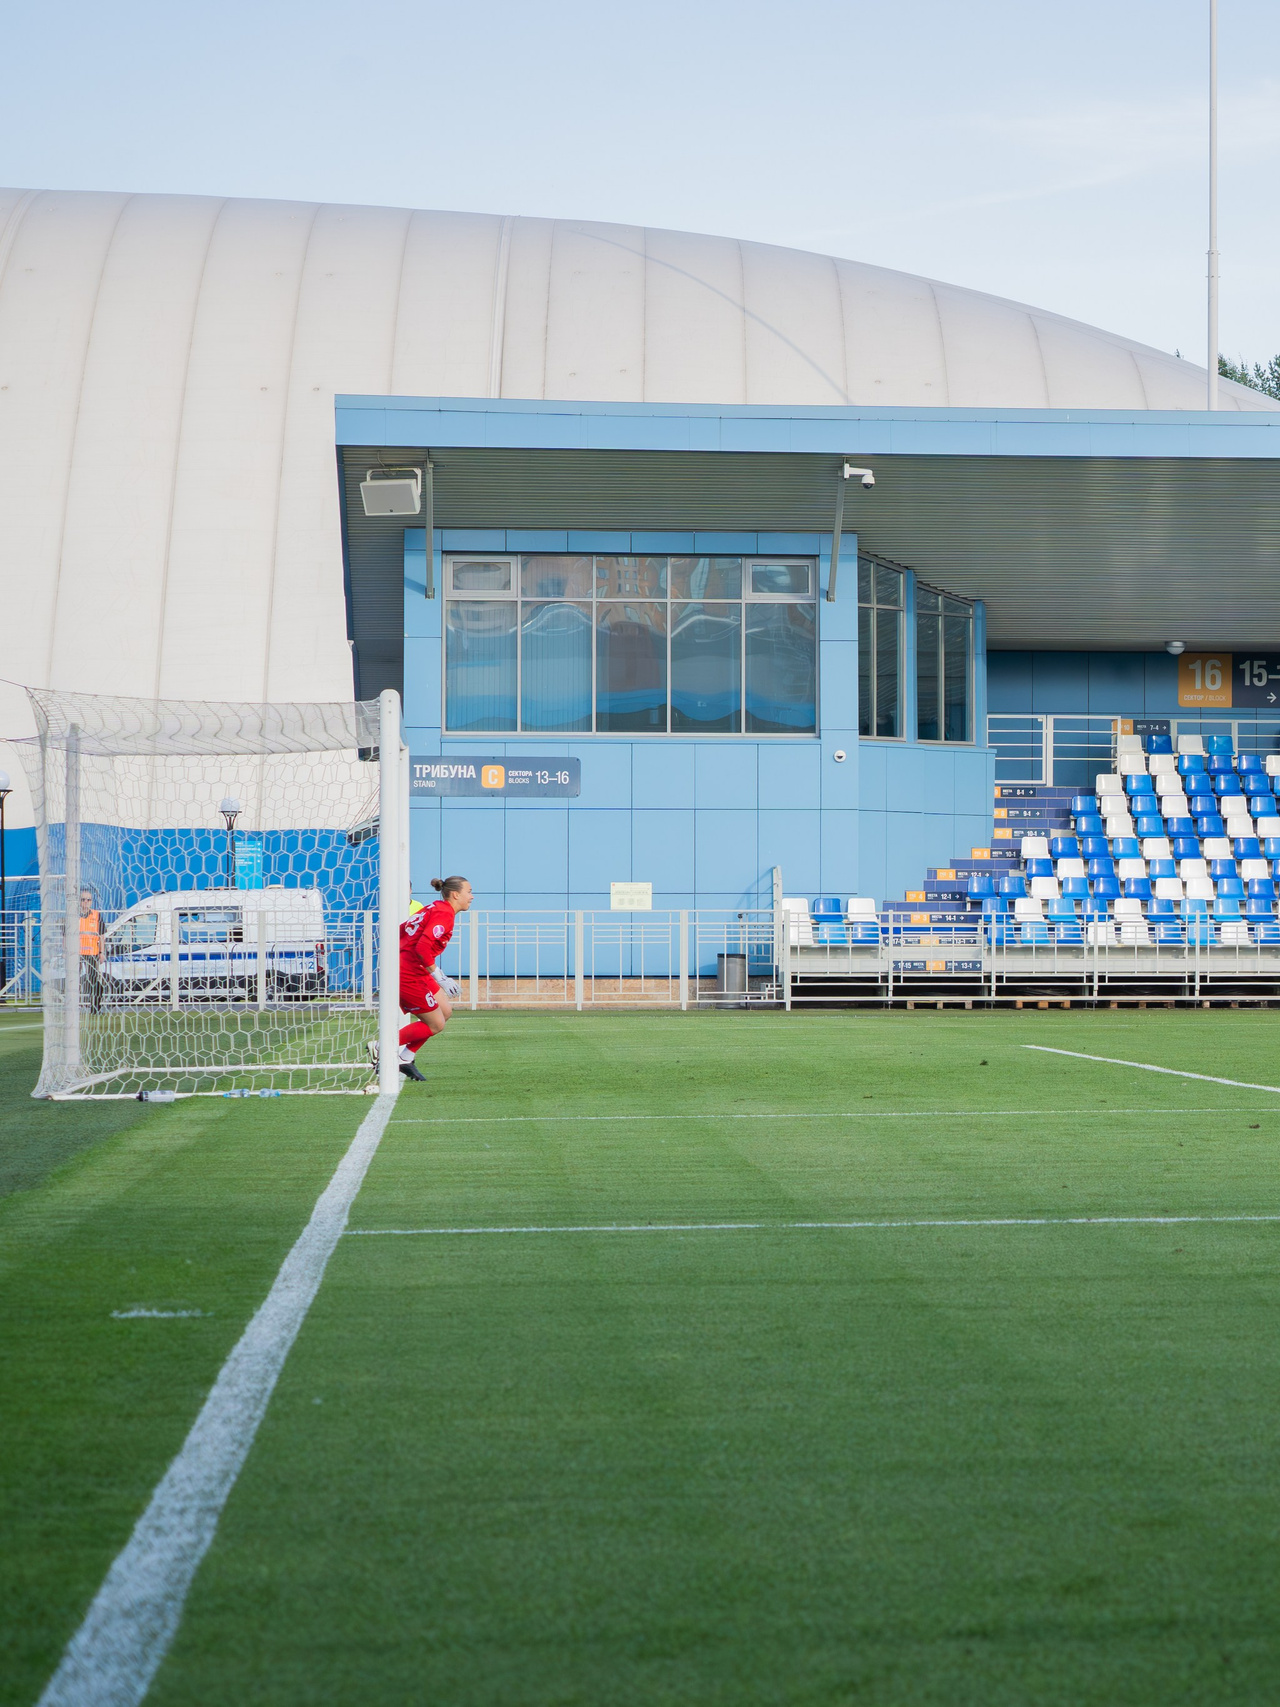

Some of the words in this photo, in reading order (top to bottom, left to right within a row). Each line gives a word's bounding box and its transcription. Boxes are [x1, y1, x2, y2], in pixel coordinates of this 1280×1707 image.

[1188, 659, 1222, 691] 16
[413, 764, 476, 779] ТРИБУНА
[413, 780, 436, 788] STAND
